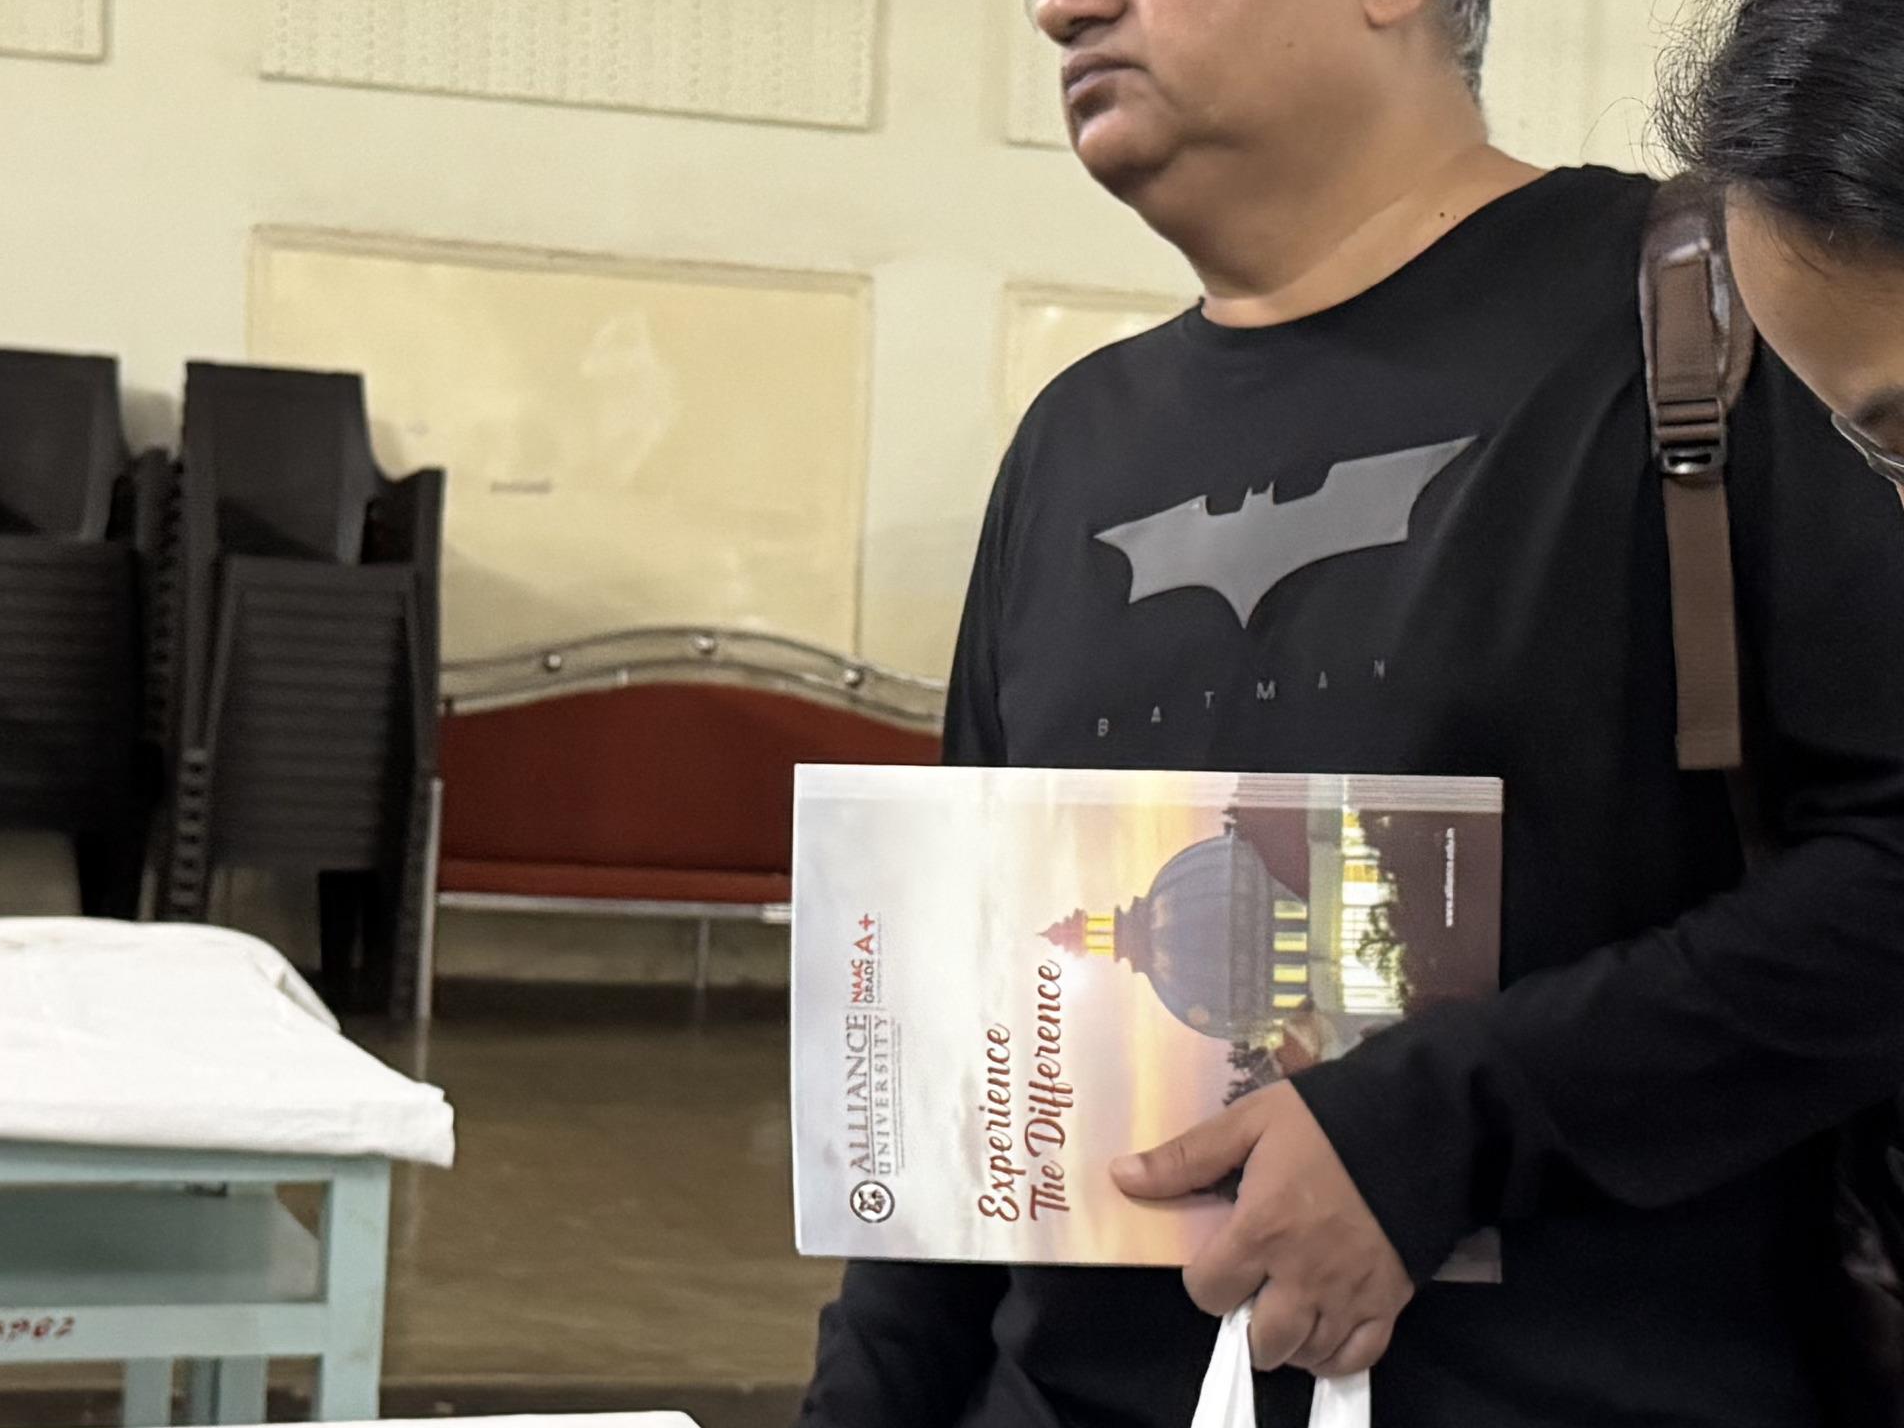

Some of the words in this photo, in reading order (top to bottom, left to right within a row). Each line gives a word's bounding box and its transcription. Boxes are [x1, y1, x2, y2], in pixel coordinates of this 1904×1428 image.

[851, 959, 864, 1004] NAAC
[863, 958, 877, 1004] GRADE
[1024, 959, 1073, 1158] Difference
[845, 1014, 871, 1174] ALLIANCE
[874, 1015, 892, 1175] UNIVERSITY
[977, 1024, 1026, 1222] Experience
[1028, 1160, 1070, 1221] The
